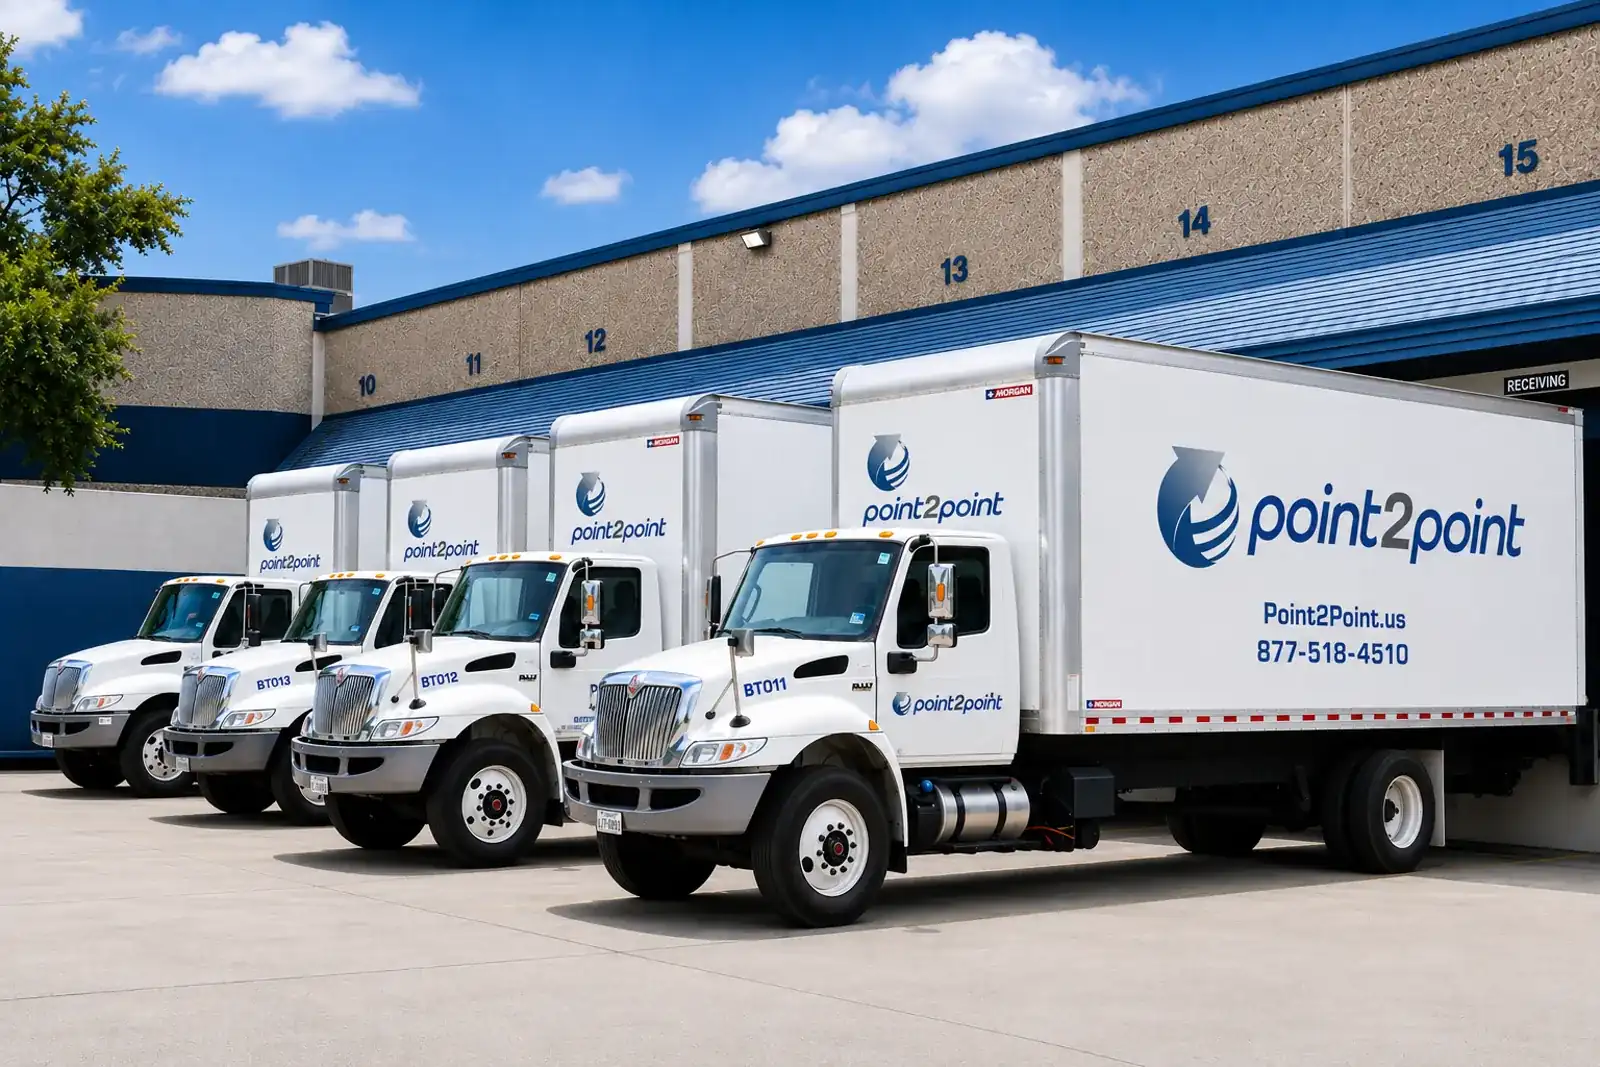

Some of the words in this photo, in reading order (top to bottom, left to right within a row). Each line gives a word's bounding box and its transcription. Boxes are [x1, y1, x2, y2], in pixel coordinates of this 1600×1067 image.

[1499, 139, 1538, 177] 15
[1178, 206, 1210, 237] 14
[941, 255, 969, 286] 13
[585, 328, 607, 354] 12
[466, 352, 481, 377] 11
[358, 374, 376, 397] 10
[994, 386, 1031, 398] MORGAN
[1507, 374, 1566, 393] RECEIVING
[863, 491, 1004, 525] point2point
[571, 515, 667, 545] point2point
[1247, 482, 1525, 564] point2point
[404, 539, 480, 562] point2point
[260, 554, 320, 574] point2point
[1264, 602, 1405, 629] Point2Point.us
[1257, 639, 1408, 666] 877-518-4510
[256, 675, 291, 691] BT013
[421, 671, 459, 688] BT012
[743, 676, 787, 698] BT011
[913, 692, 1003, 715] point2point
